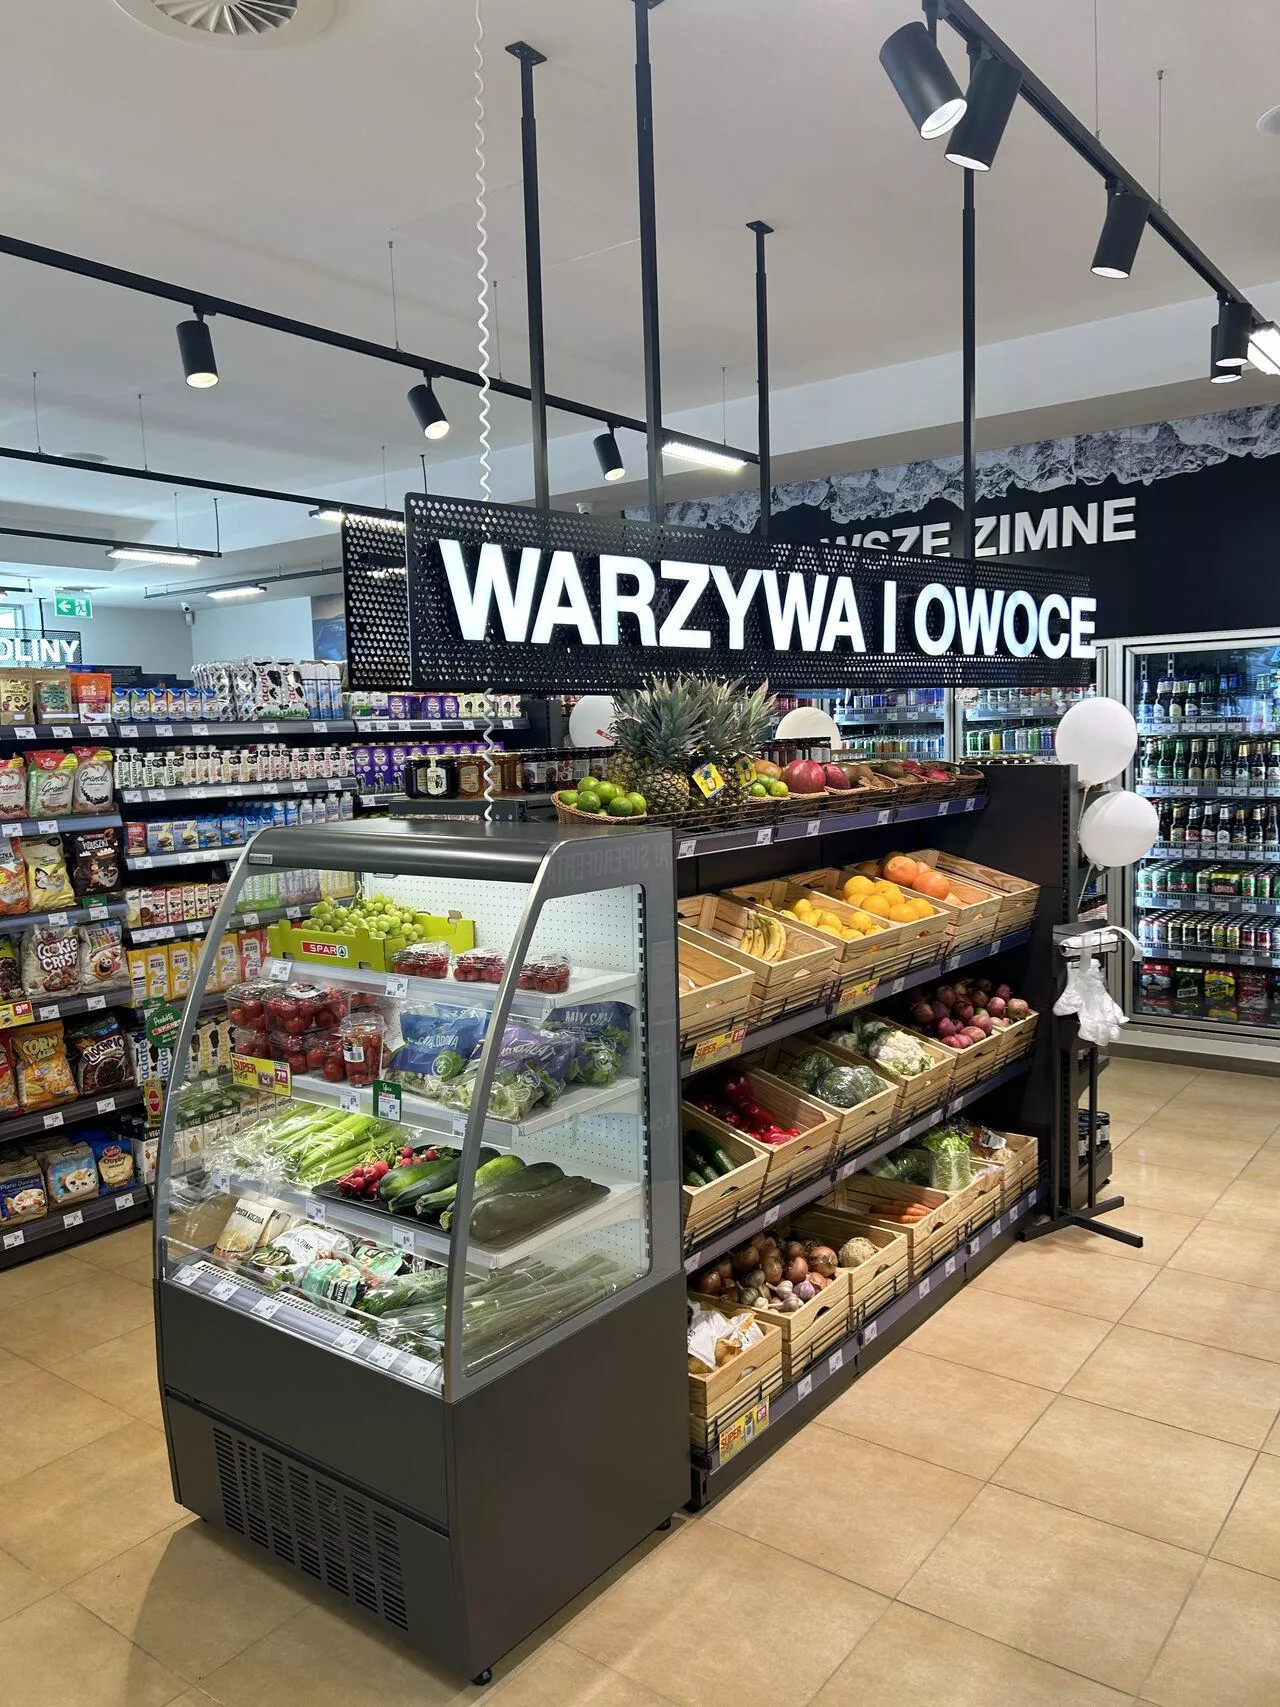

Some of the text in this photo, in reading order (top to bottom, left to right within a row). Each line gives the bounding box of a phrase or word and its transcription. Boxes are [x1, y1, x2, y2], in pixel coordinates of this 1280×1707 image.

[975, 497, 1136, 557] ZIMNE
[438, 539, 1097, 660] WARZYWA I OWOCE
[309, 944, 337, 955] SPAR
[233, 1060, 257, 1074] SUPER
